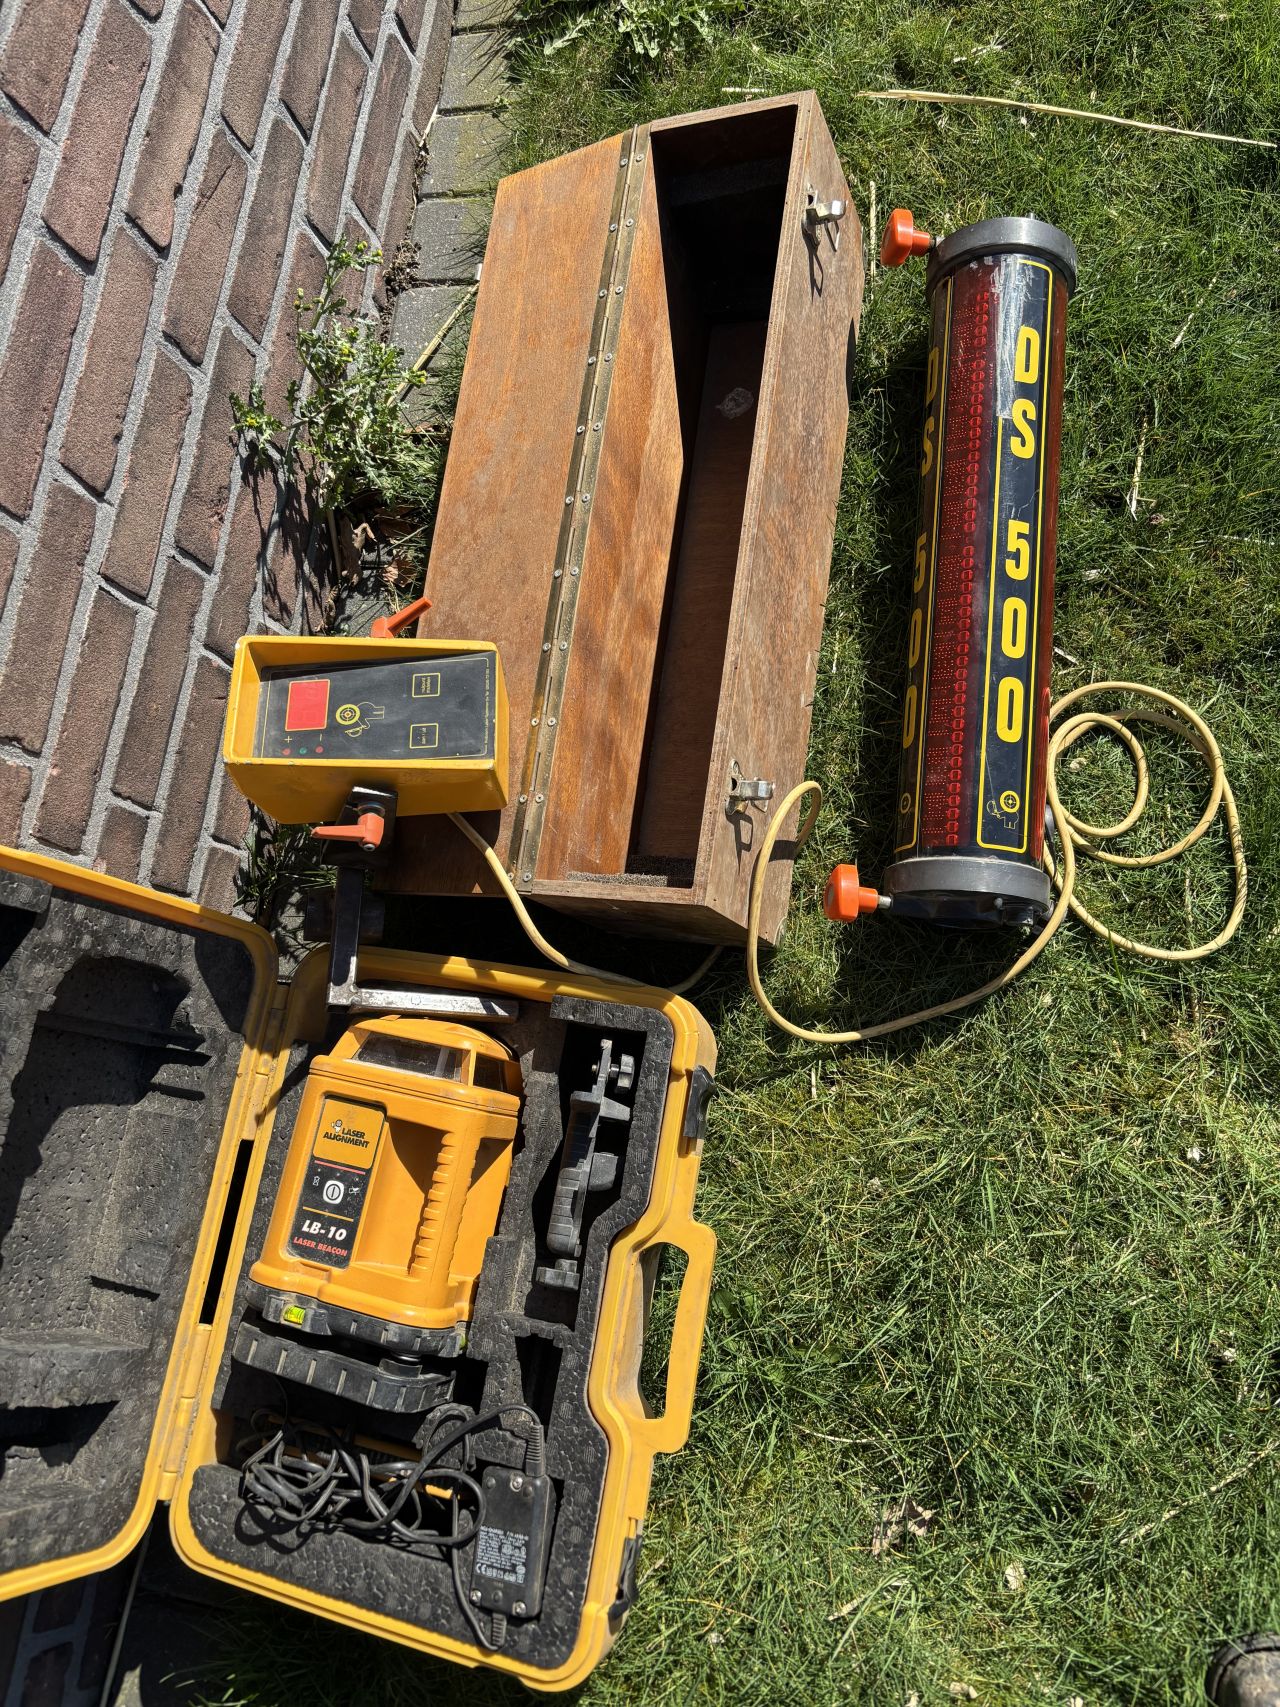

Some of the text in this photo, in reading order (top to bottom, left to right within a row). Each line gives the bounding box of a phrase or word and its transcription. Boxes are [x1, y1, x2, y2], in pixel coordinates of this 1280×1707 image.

[997, 325, 1040, 743] DS 500
[323, 1131, 369, 1148] ALIGNMENT
[342, 1127, 365, 1139] LASER
[302, 1219, 347, 1241] LB-10
[293, 1237, 347, 1256] LASER BEACON
